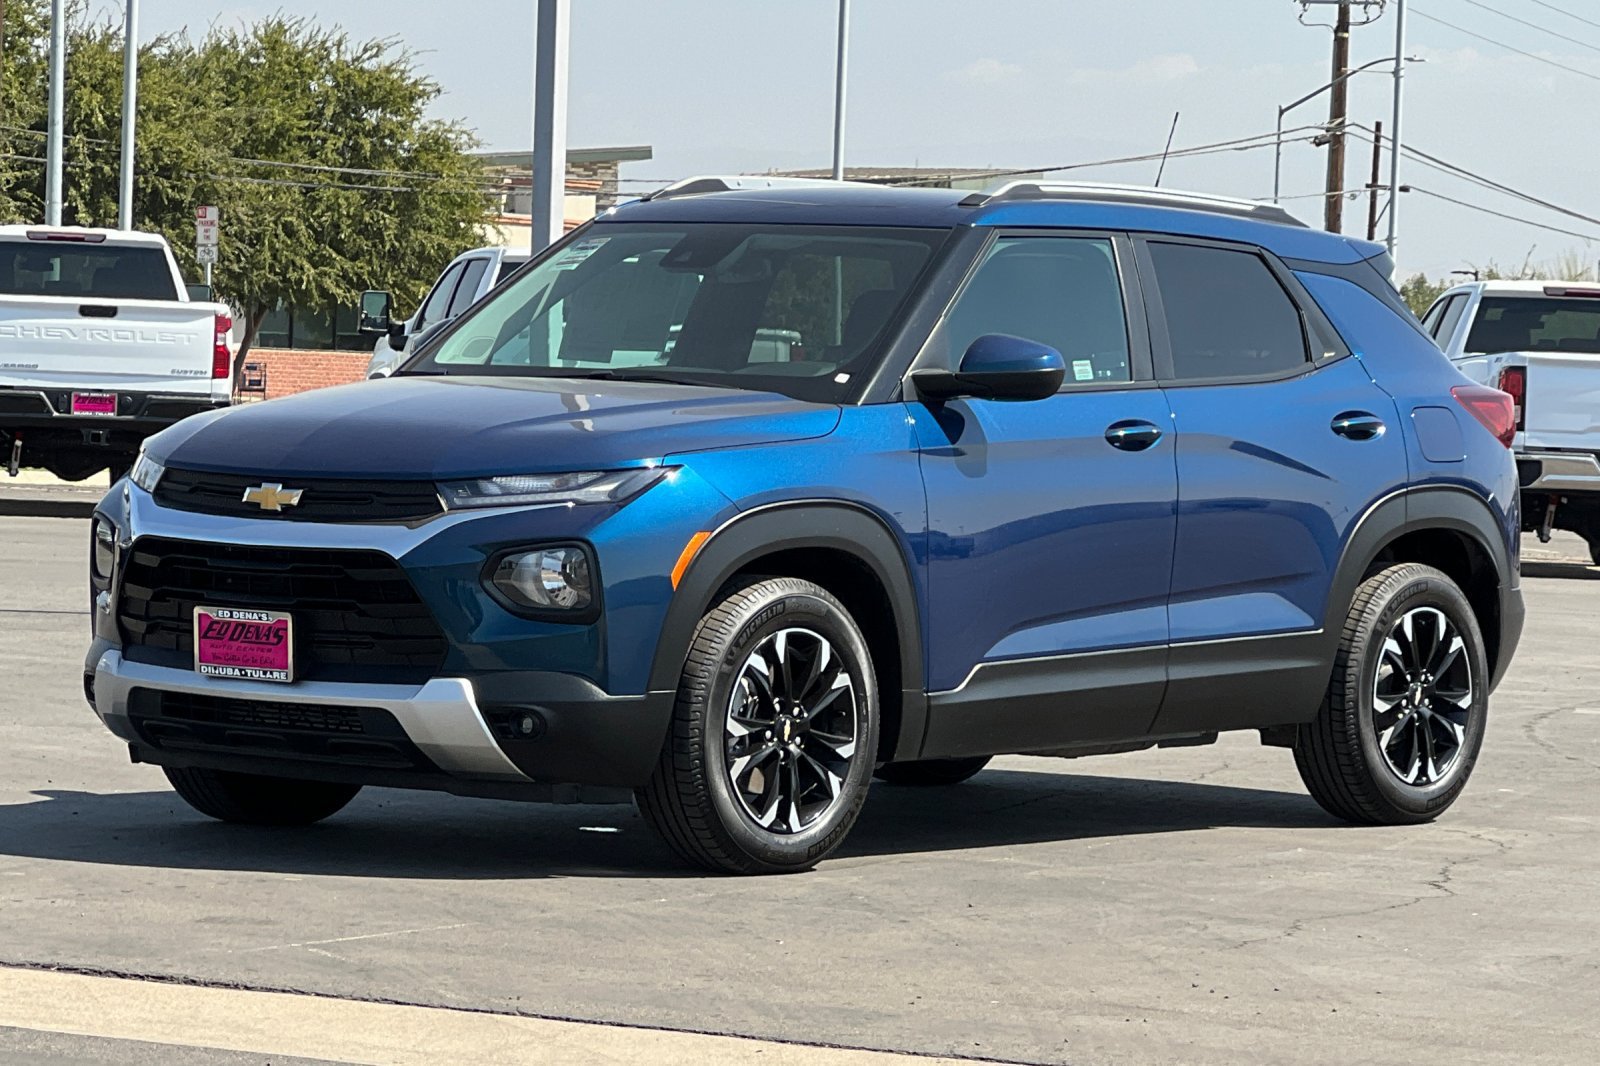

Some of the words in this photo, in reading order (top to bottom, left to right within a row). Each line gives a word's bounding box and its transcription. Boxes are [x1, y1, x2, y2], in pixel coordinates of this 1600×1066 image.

[0, 325, 198, 345] CHEVROLET
[233, 612, 267, 620] DENA'S
[738, 602, 785, 648] MICHELIN
[202, 620, 232, 641] ED
[201, 666, 240, 675] DINUBA
[246, 670, 286, 680] TULARE
